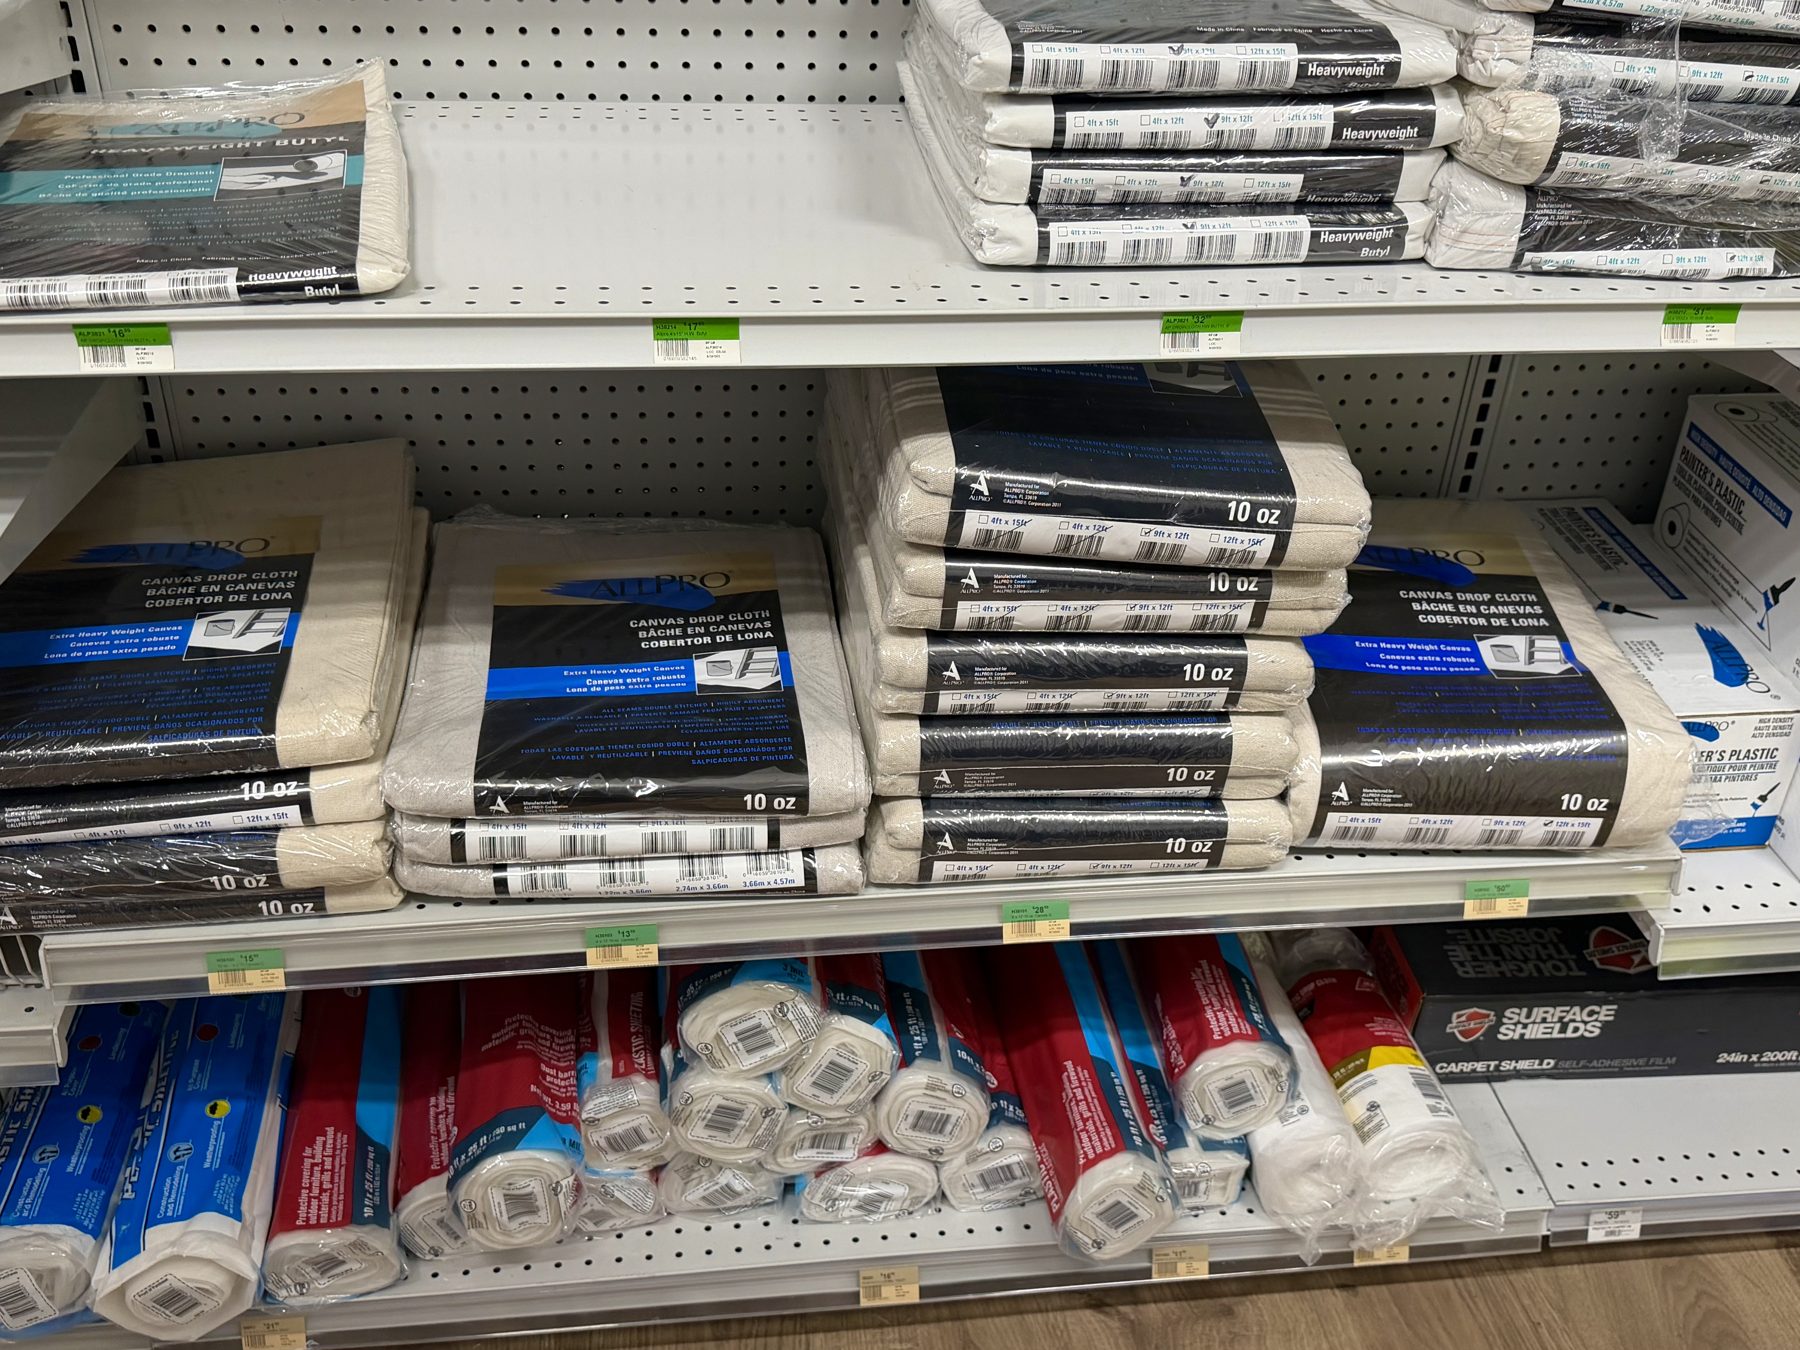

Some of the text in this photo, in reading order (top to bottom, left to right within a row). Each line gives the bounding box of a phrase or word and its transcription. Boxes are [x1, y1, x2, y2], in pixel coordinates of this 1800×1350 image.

[1307, 63, 1386, 78] Heavyweight
[1692, 69, 1703, 78] 9ft
[1710, 70, 1724, 79] 12ft
[1756, 74, 1770, 82] 12ft
[1777, 76, 1791, 84] 15ft
[1221, 115, 1232, 124] 9ft
[1239, 114, 1253, 123] 12ft
[275, 136, 349, 147] BUTYL
[1342, 126, 1419, 141] Heavyweight
[1320, 228, 1394, 243] Heavyweight
[1360, 245, 1391, 258] Butyl
[248, 265, 338, 283] Heavyweight
[304, 283, 341, 298] Butyl
[1715, 477, 1746, 516] PLASTIC
[1228, 501, 1281, 525] 10 oz
[1154, 530, 1165, 538] 9ft
[1175, 532, 1190, 541] 12ft
[142, 570, 299, 586] CANVAS DROP CLOTH
[1208, 572, 1259, 592] 10 oz
[146, 580, 296, 596] BÂCHE EN CANEVAS
[1399, 590, 1539, 602] CANVAS DROP CLOTH
[145, 592, 294, 608] COBERTOR DE LONA
[1411, 600, 1544, 615] BÂCHE EN CANEVAS
[629, 609, 770, 628] CANVAS DROP CLOTH
[1418, 614, 1550, 627] COBERTOR DE LONA
[50, 625, 183, 641] Extra Heavy Weight Canvas
[638, 621, 772, 639] BÂCHE EN CANEVAS
[641, 631, 775, 649] COBERTOR DE LONA
[1354, 640, 1472, 652] Extra Heavy Weight Canvas
[1183, 663, 1234, 681] 10 oz
[1772, 716, 1794, 724] DENSITY
[1767, 730, 1792, 738] DENSIDAD
[690, 756, 748, 765] SALPICADURAS
[762, 754, 796, 762] PINTURA
[1728, 747, 1779, 762] PLASTIC
[1166, 768, 1216, 782] 10 oz
[1728, 764, 1747, 773] POUR
[1749, 762, 1777, 771] PEINTRE
[1724, 774, 1759, 783] PINTORES
[240, 781, 300, 801] 10 oz
[743, 794, 797, 811] 10 oz
[1560, 793, 1610, 812] 10 oz
[247, 814, 263, 823] 12ft
[273, 812, 289, 821] 15ft
[1165, 838, 1214, 853] 10 oz
[210, 874, 270, 892] 10 oz
[742, 880, 765, 889] 3.66m
[258, 900, 316, 917] 10 oz
[1443, 943, 1577, 962] THAN THE
[1453, 960, 1587, 978] TOUGHER
[1502, 1004, 1619, 1024] SURFACE
[1496, 1022, 1604, 1041] SHIELDS
[1435, 1056, 1677, 1074] CARPET SHIELD SELF-ADHESIVE FILM
[1716, 1050, 1798, 1064] 24in x 200ft
[66, 1125, 91, 1173] Weatherproofing
[203, 1119, 222, 1169] Weatherproofing
[312, 1135, 326, 1163] building
[318, 1126, 335, 1224] materials, grills and firewood
[296, 1146, 314, 1225] Protective covering for
[156, 1176, 172, 1219] Construction
[307, 1198, 319, 1225] outdoor
